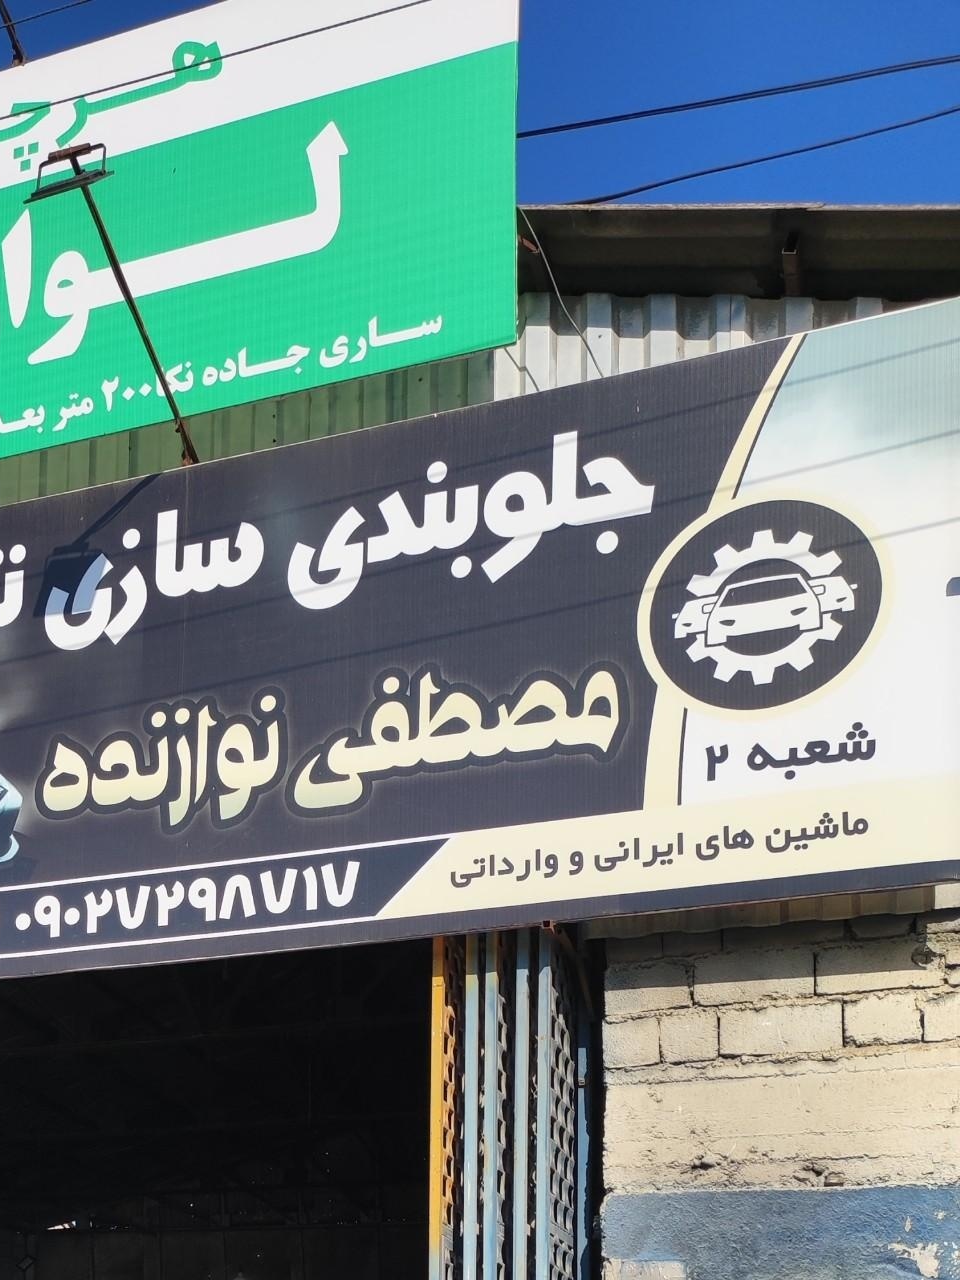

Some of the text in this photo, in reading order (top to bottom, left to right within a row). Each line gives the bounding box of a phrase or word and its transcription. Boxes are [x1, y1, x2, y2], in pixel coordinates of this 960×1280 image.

[202, 342, 310, 386] جاده
[319, 314, 444, 370] ساری
[53, 392, 94, 431] متر
[287, 430, 655, 609] جلوبندی
[44, 509, 265, 650] سازی
[41, 669, 619, 827] مصطفی نوازنده
[705, 721, 876, 781] شعبه ۲
[450, 811, 869, 888] ماشین های ایرانی و وارداتی
[15, 860, 360, 938] ۰۹۰۲۷۲۹۸۷۱۷
